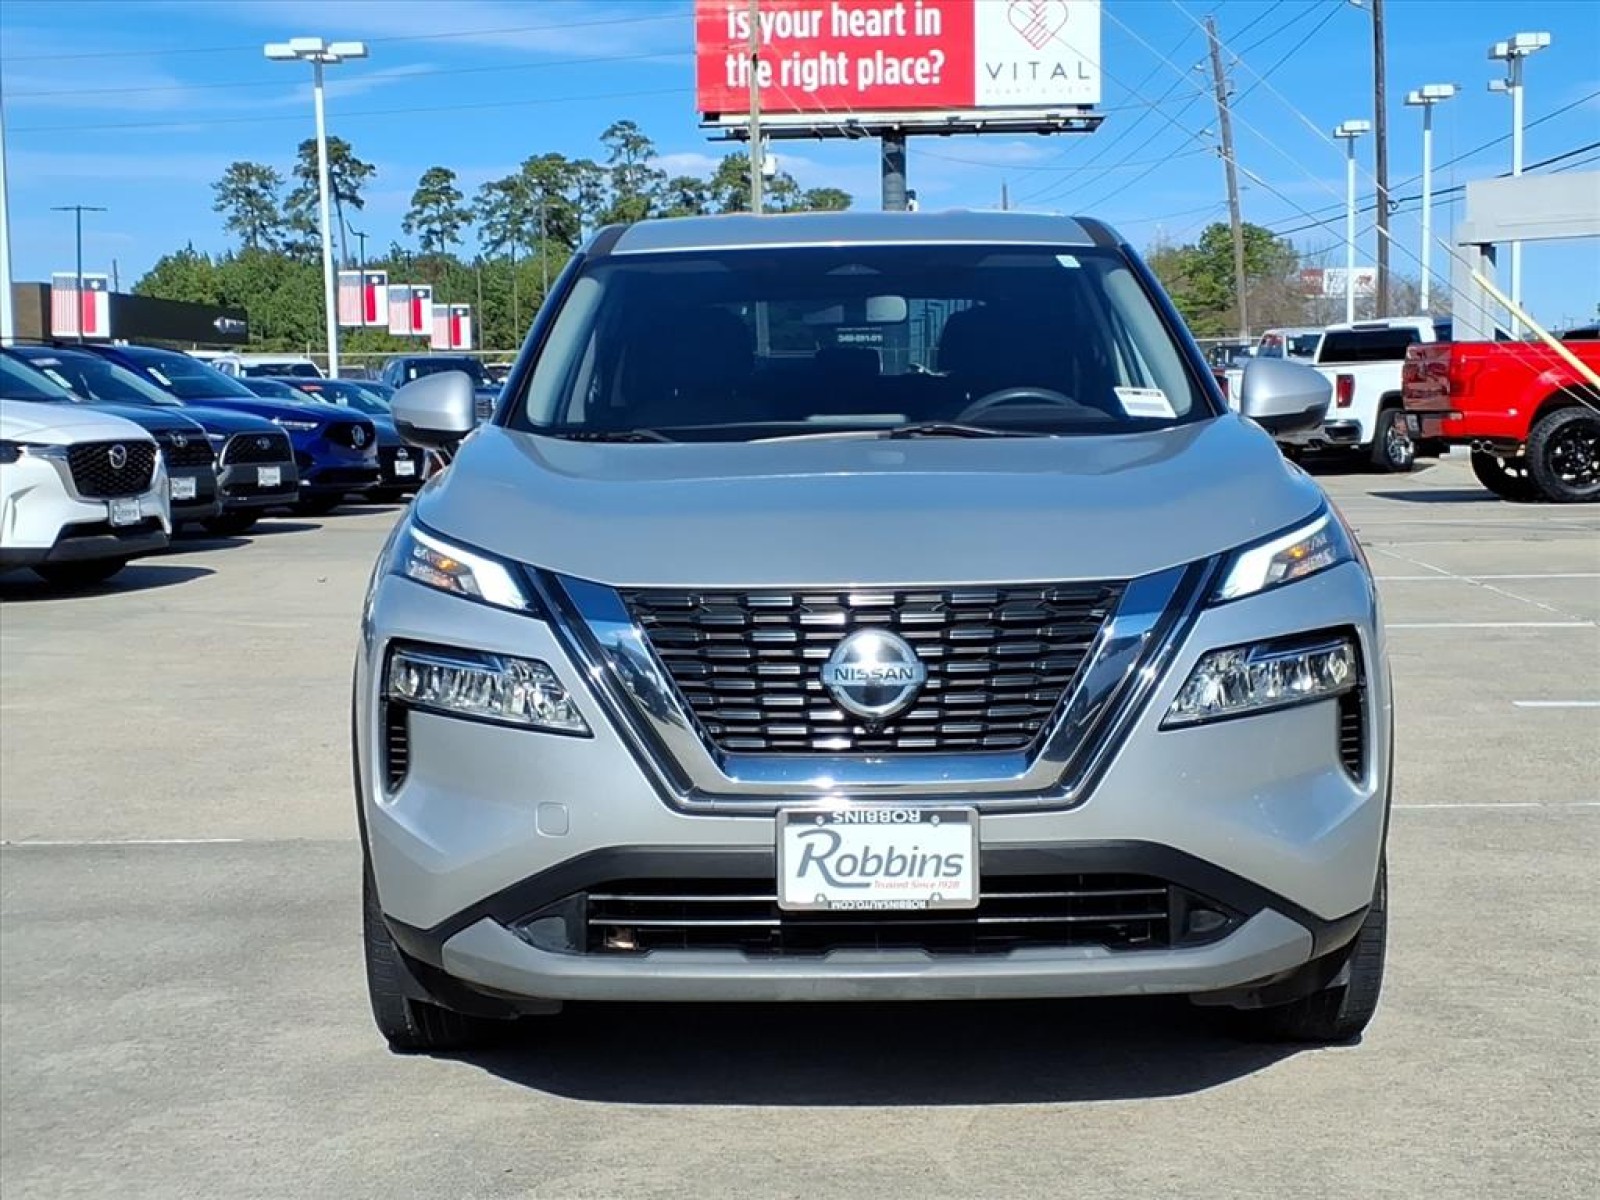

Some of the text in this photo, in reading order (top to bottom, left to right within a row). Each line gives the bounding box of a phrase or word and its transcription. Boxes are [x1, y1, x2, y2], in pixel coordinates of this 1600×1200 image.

[727, 0, 942, 45] is your heart in
[725, 49, 946, 93] the right place?
[985, 61, 1091, 81] VITAL
[834, 667, 914, 681] NISSAN
[832, 809, 921, 823] ROBBINS
[796, 828, 965, 888] Robbins
